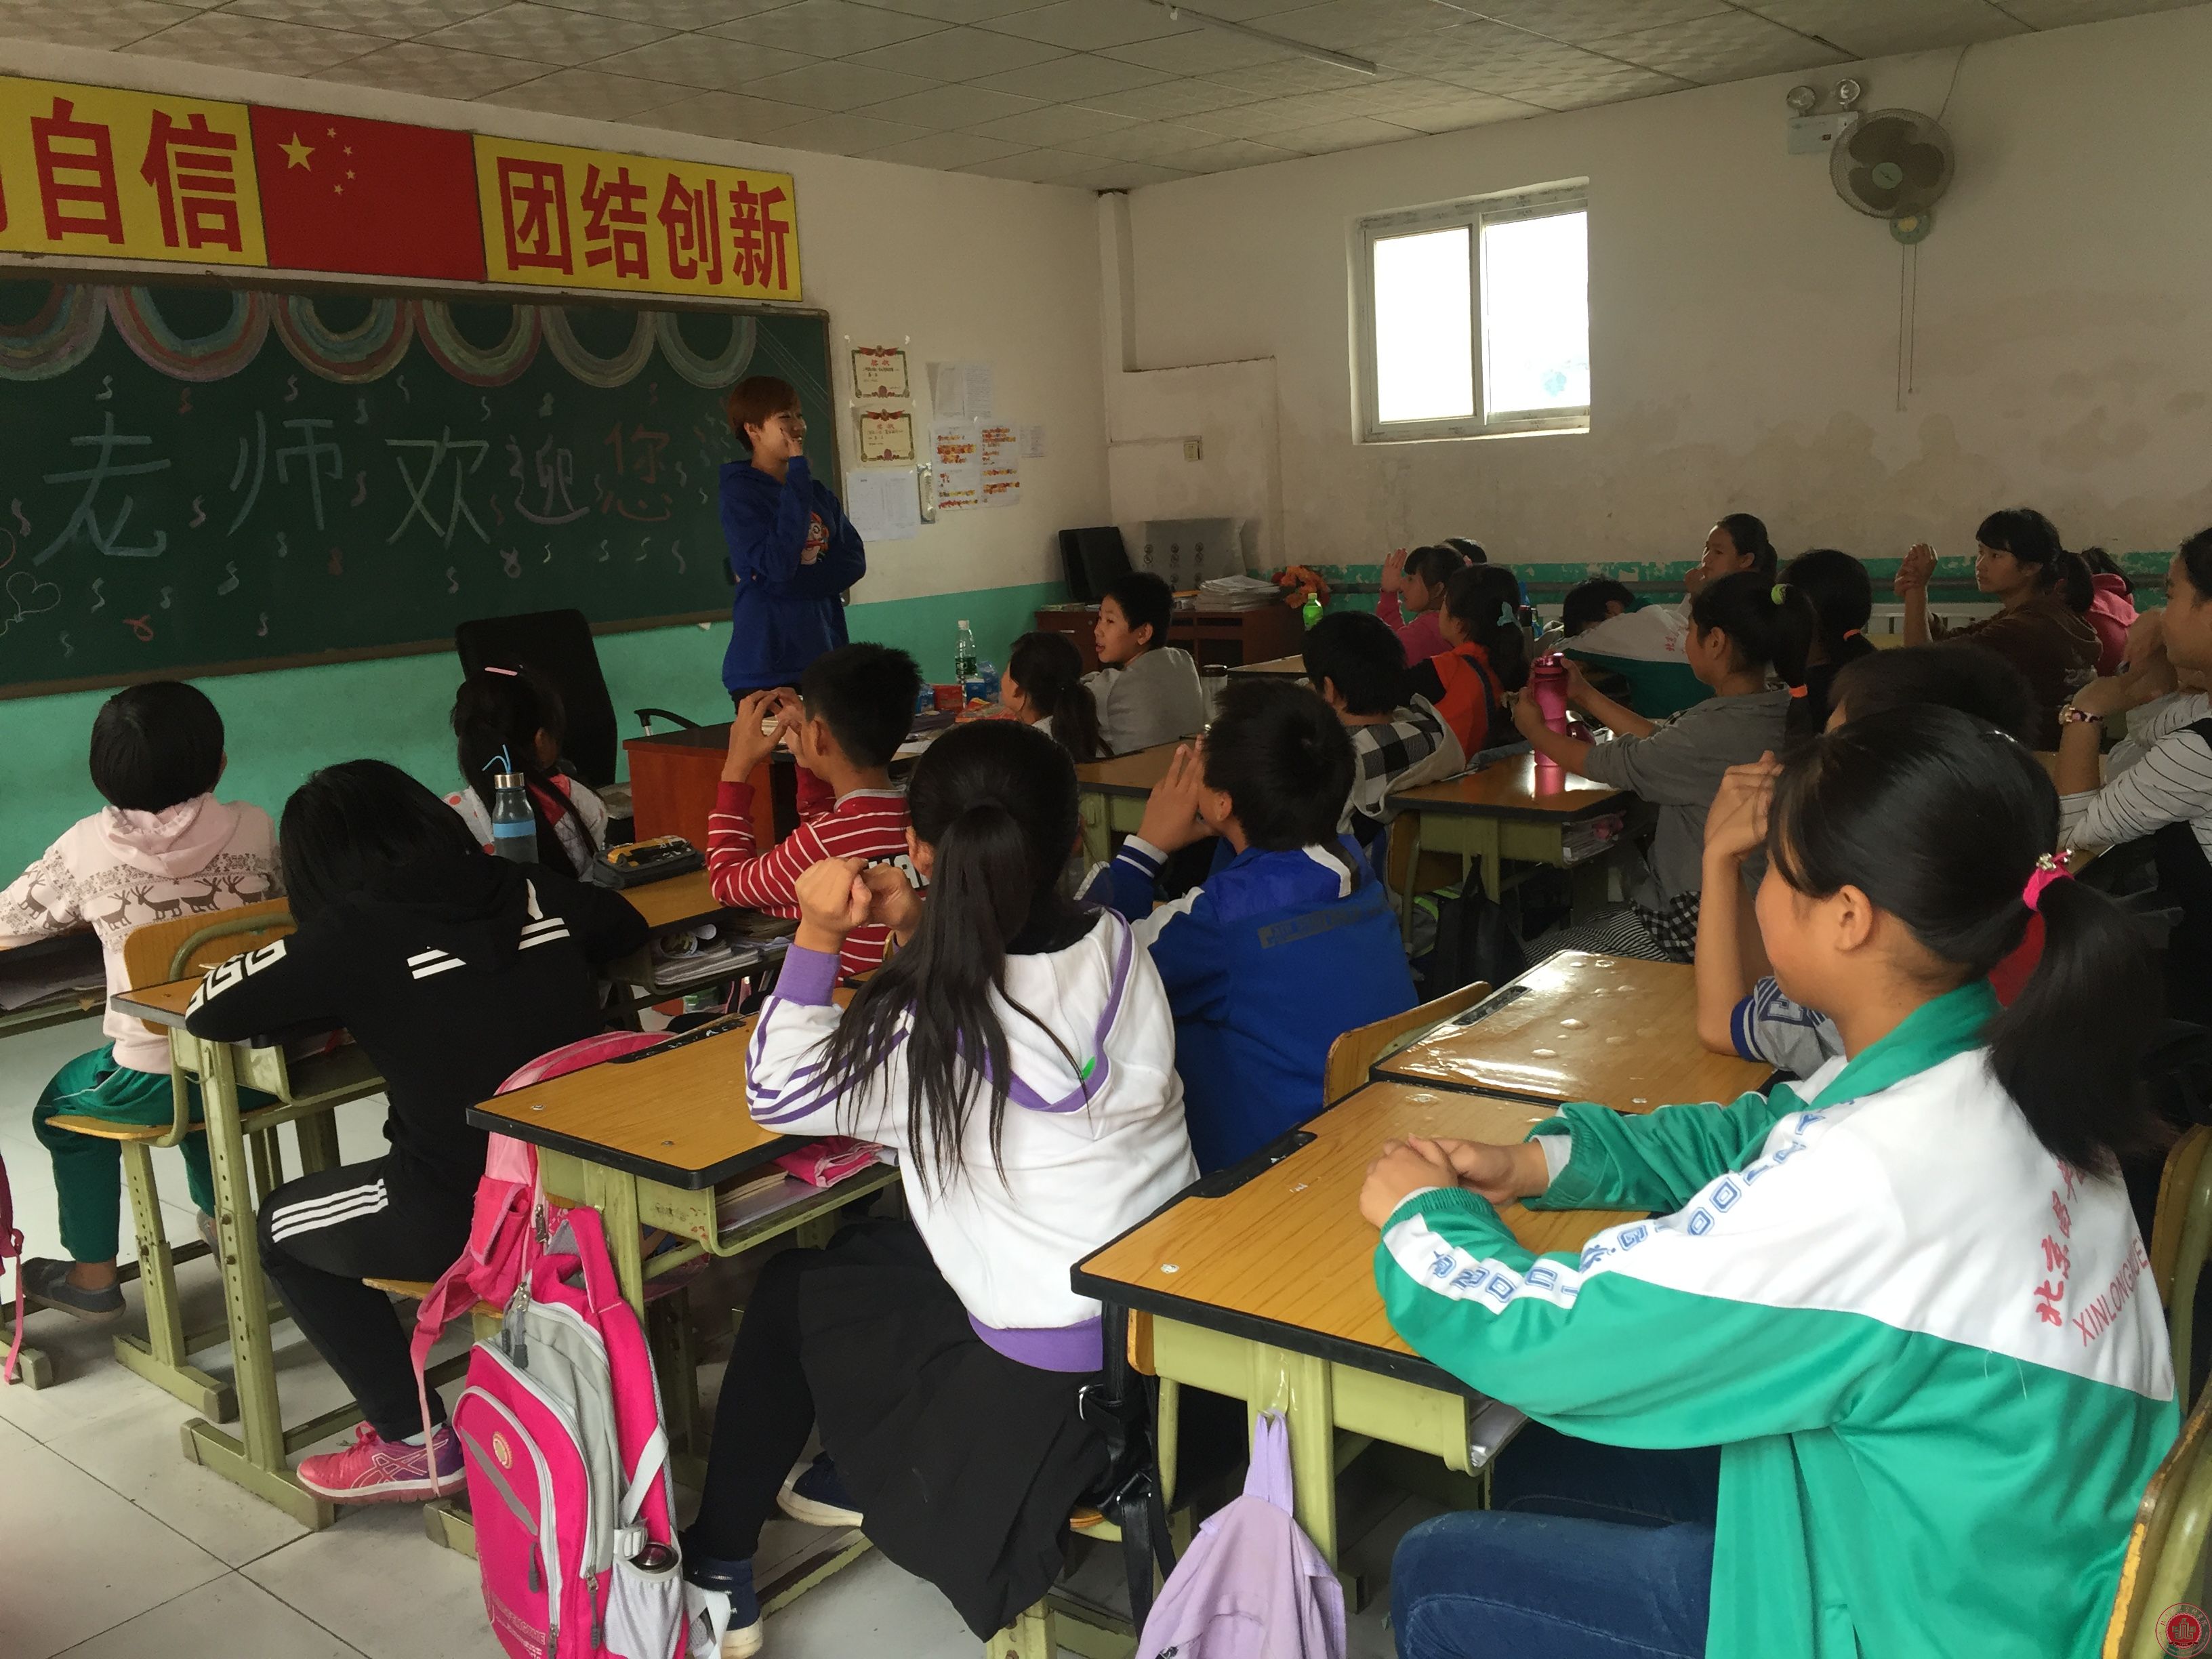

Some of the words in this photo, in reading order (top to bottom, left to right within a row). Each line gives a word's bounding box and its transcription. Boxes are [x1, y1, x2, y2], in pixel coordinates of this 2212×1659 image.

[0, 97, 243, 253] 自信
[496, 156, 791, 291] 团结创新
[33, 410, 673, 567] 老师欢迎您
